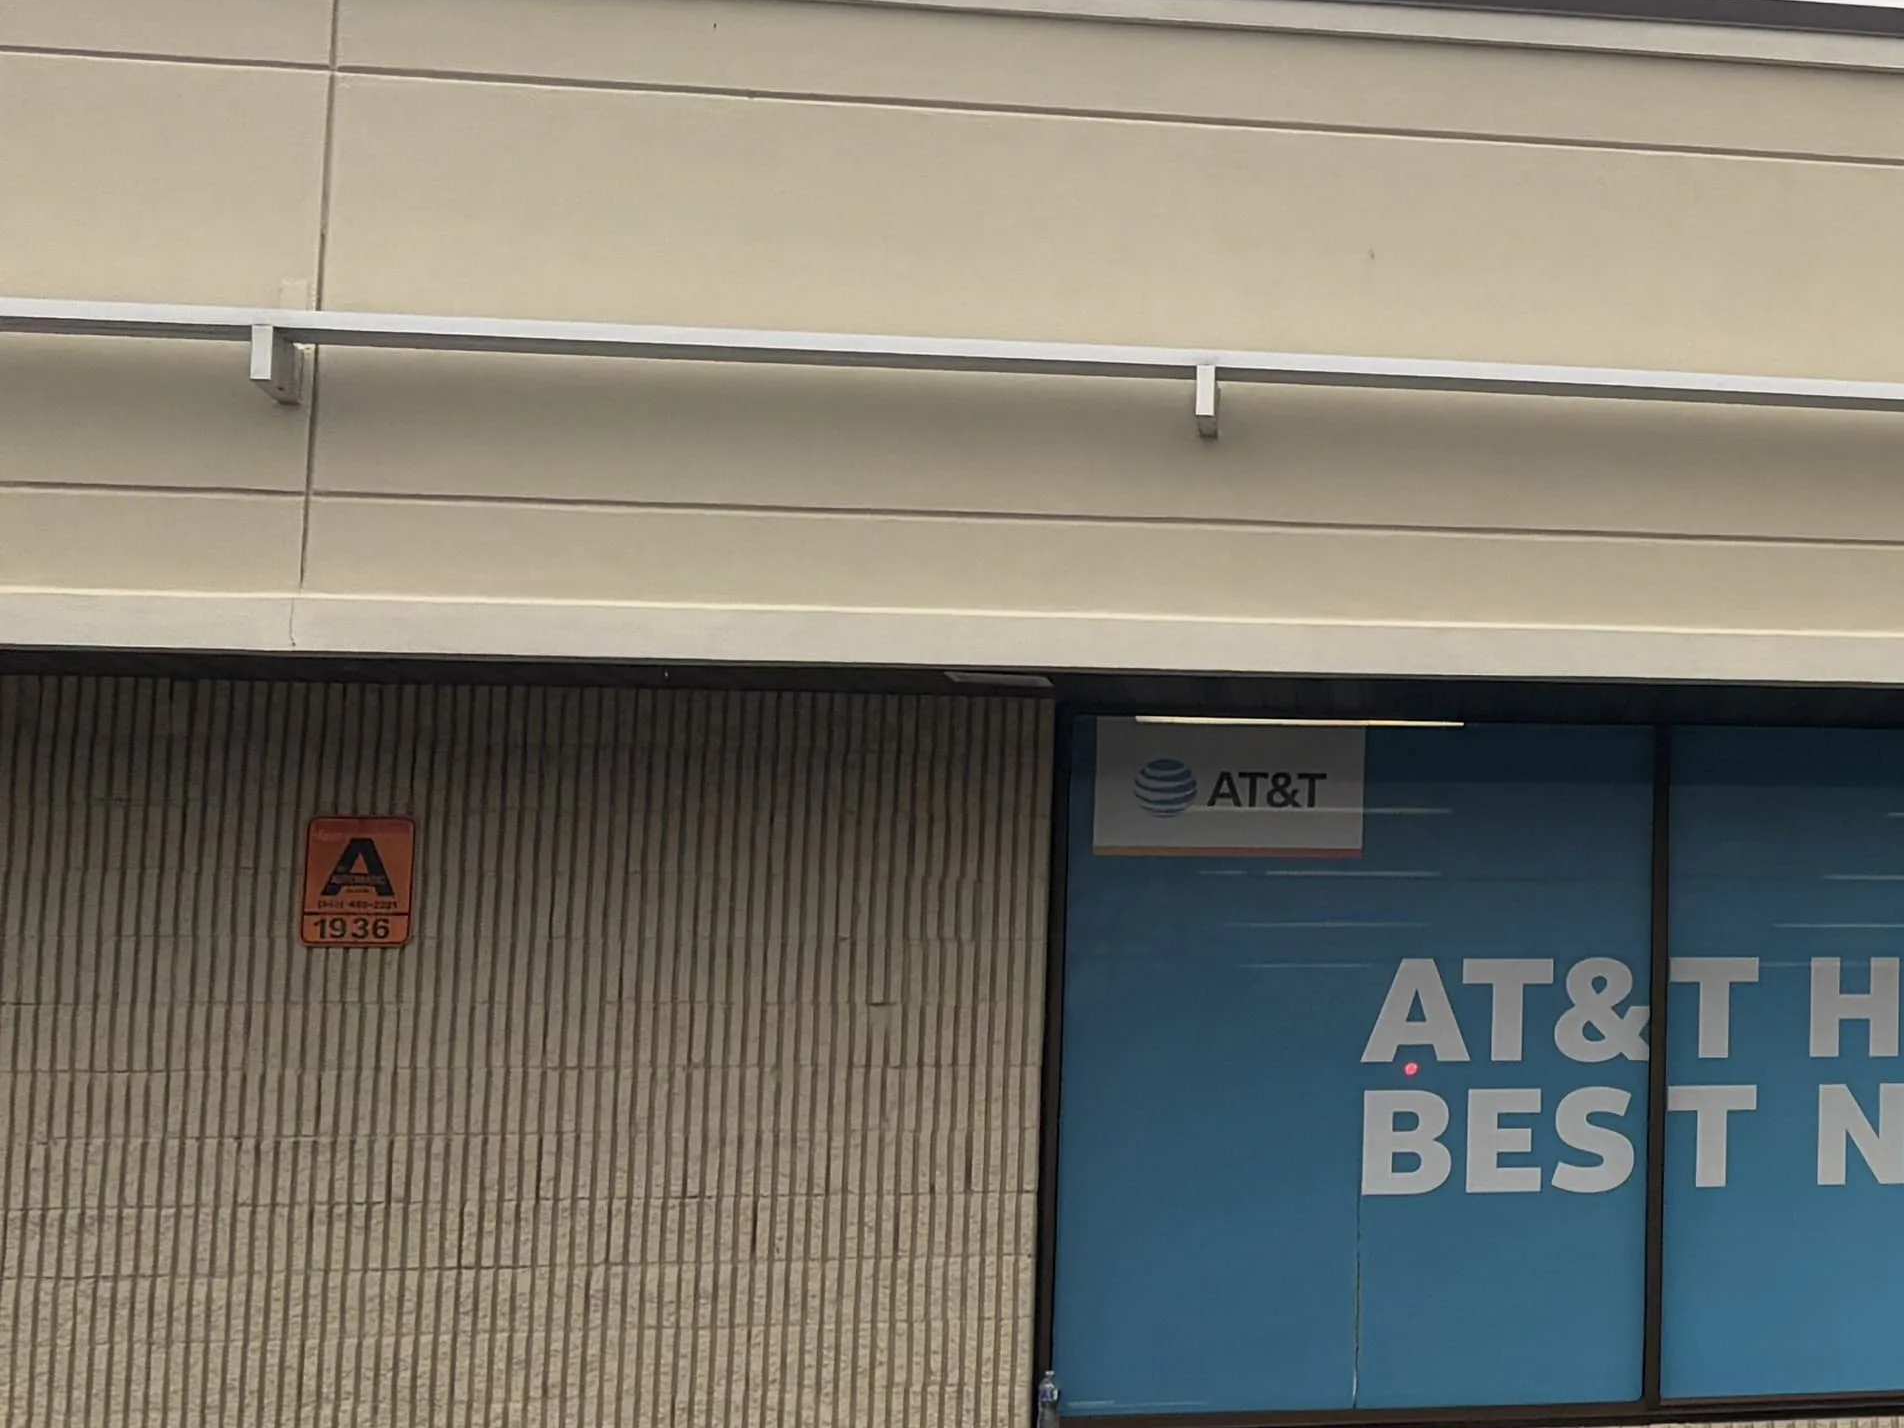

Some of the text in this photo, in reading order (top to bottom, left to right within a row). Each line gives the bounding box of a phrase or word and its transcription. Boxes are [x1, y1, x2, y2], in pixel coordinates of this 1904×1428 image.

[1207, 771, 1327, 808] AT&T
[321, 838, 395, 896] A
[313, 917, 390, 940] 1936
[1360, 955, 1761, 1064] AT&T
[1361, 1085, 1758, 1198] BEST
